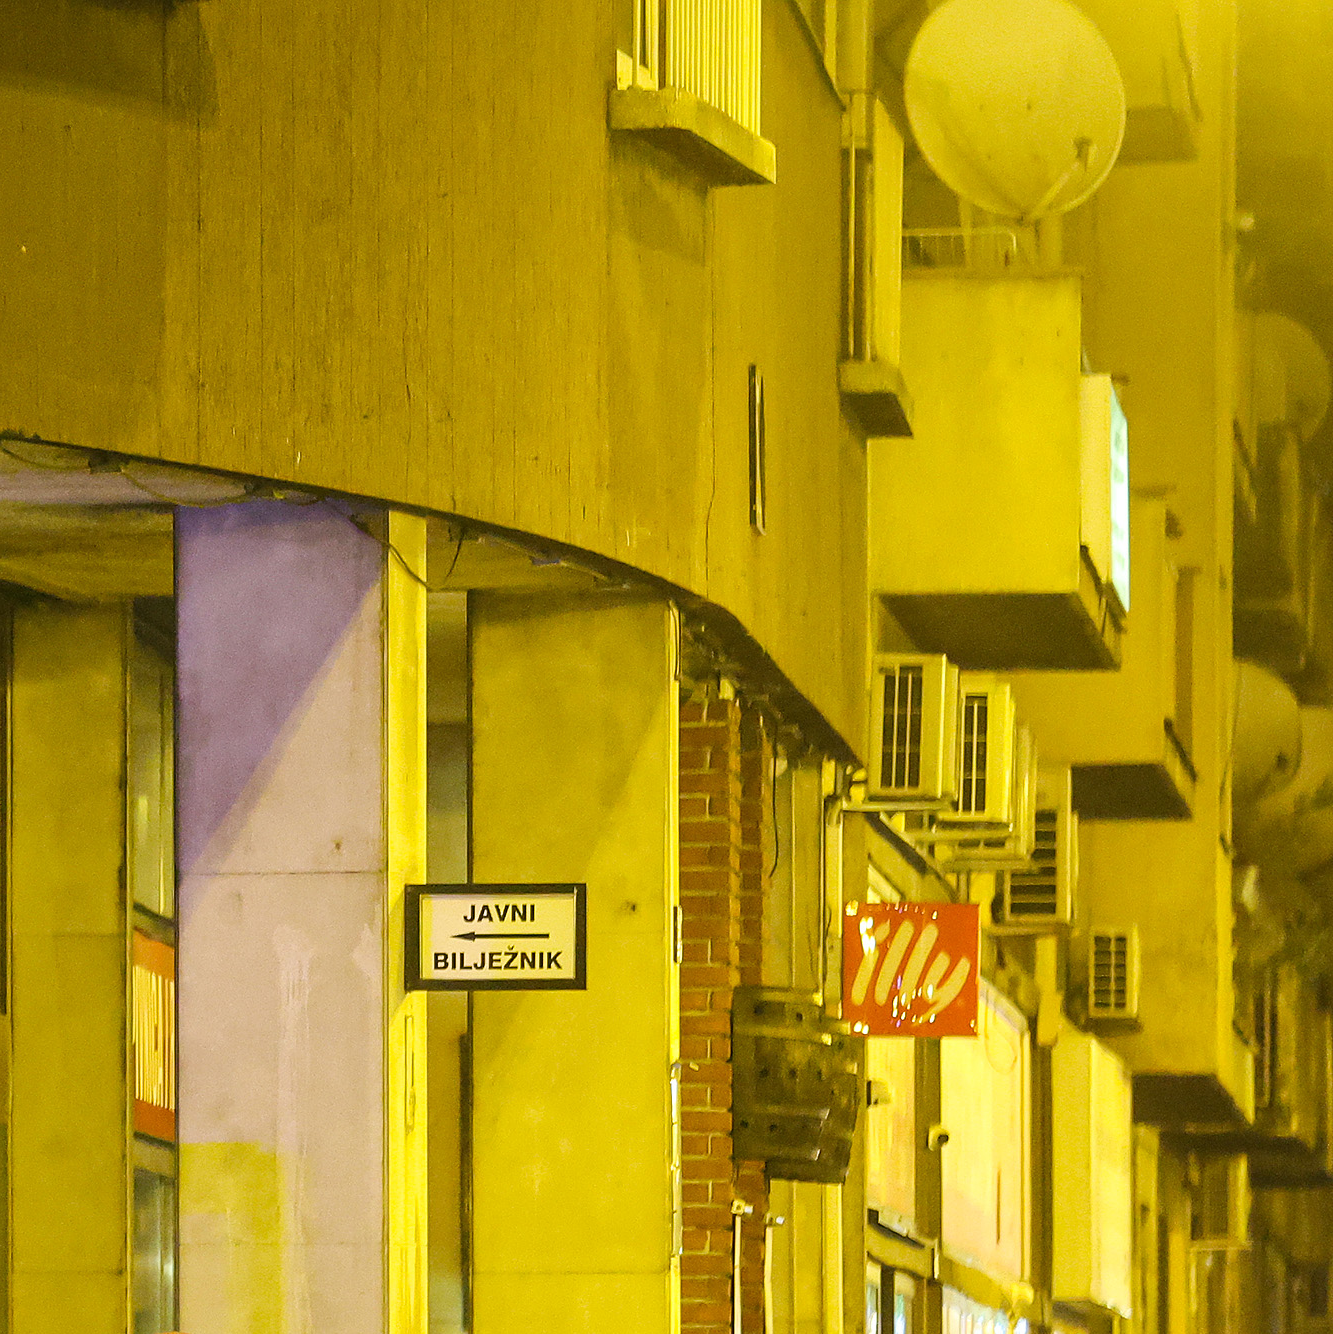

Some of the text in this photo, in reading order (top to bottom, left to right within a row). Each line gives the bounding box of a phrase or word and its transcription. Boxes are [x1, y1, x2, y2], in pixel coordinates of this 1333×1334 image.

[463, 903, 536, 923] JAVNI
[433, 944, 564, 971] BILJEŽNIK
[850, 917, 971, 1027] illy
